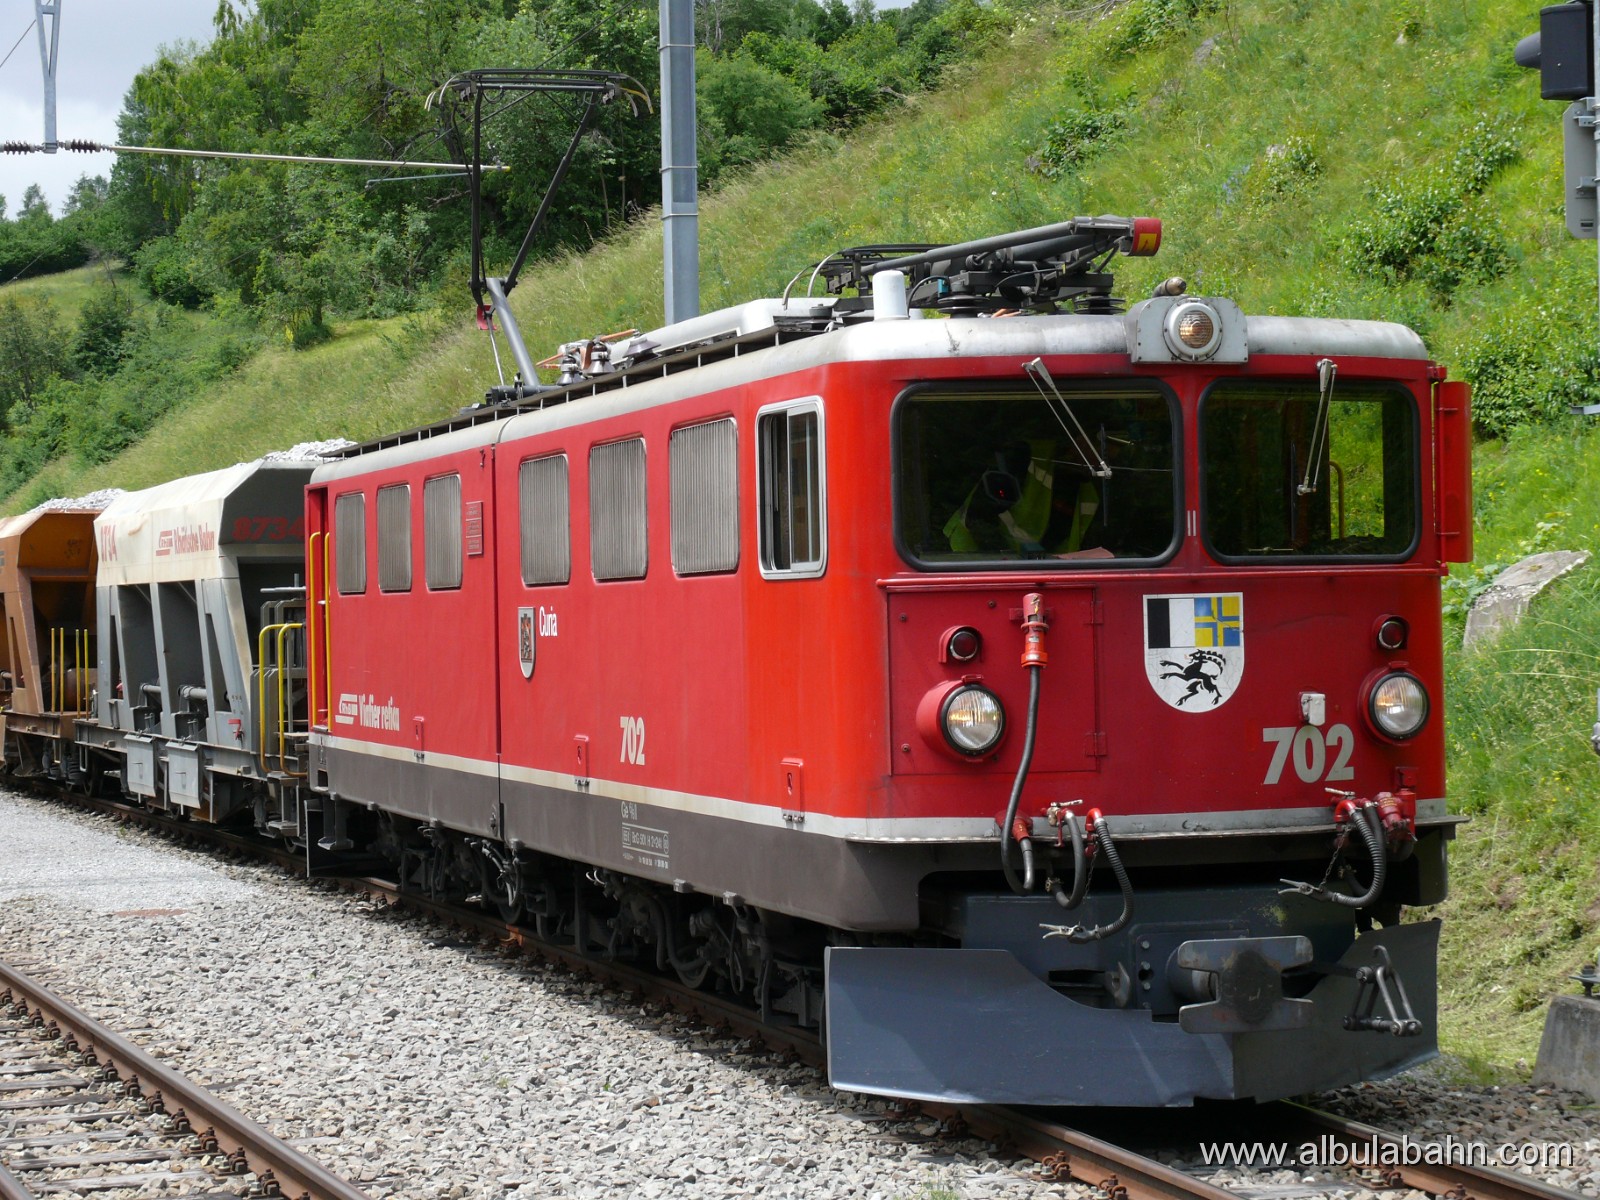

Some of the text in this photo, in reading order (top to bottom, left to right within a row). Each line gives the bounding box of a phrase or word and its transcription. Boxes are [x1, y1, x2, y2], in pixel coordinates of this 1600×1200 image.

[232, 516, 305, 541] 8734
[619, 715, 646, 766] 702
[1262, 723, 1355, 785] 702
